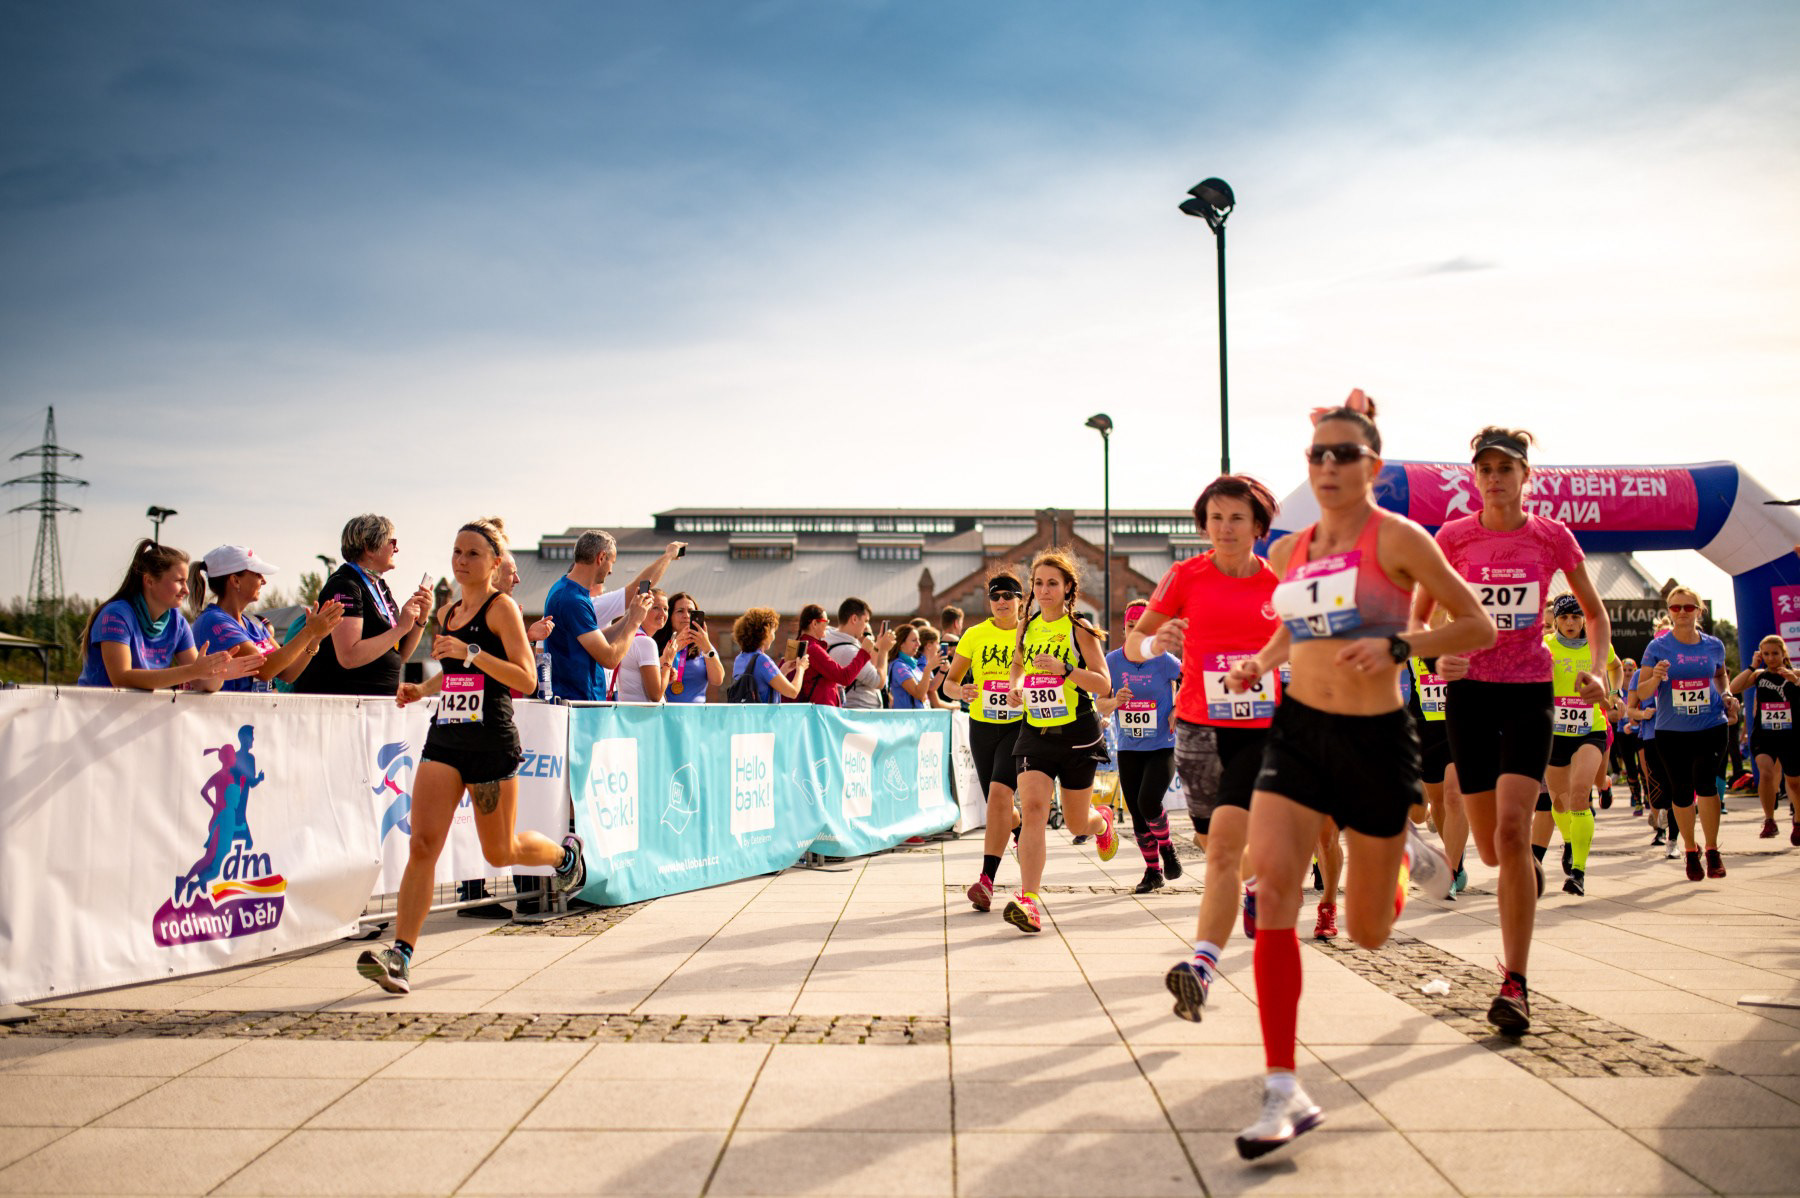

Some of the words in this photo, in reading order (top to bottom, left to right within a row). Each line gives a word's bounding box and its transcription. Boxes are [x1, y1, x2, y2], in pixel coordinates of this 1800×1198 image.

[1531, 474, 1563, 496] KÝ
[1570, 473, 1617, 497] BĚH
[1621, 475, 1667, 497] ŽEN
[1523, 500, 1601, 524] TRAVA
[1306, 581, 1320, 603] 1
[1480, 587, 1528, 606] 207
[1609, 604, 1623, 622] LÍ
[1217, 676, 1264, 695] 18
[441, 694, 480, 711] 1420
[1029, 689, 1057, 704] 380
[1679, 690, 1705, 702] 124
[1125, 712, 1151, 724] 860
[1559, 708, 1587, 721] 304
[1765, 711, 1787, 720] 242
[518, 749, 563, 779] ŽEN
[735, 755, 767, 783] Hello
[844, 752, 867, 774] Hello
[735, 782, 770, 812] bank!
[222, 844, 273, 881] dm
[160, 908, 233, 940] rodinný
[238, 902, 277, 929] běh
